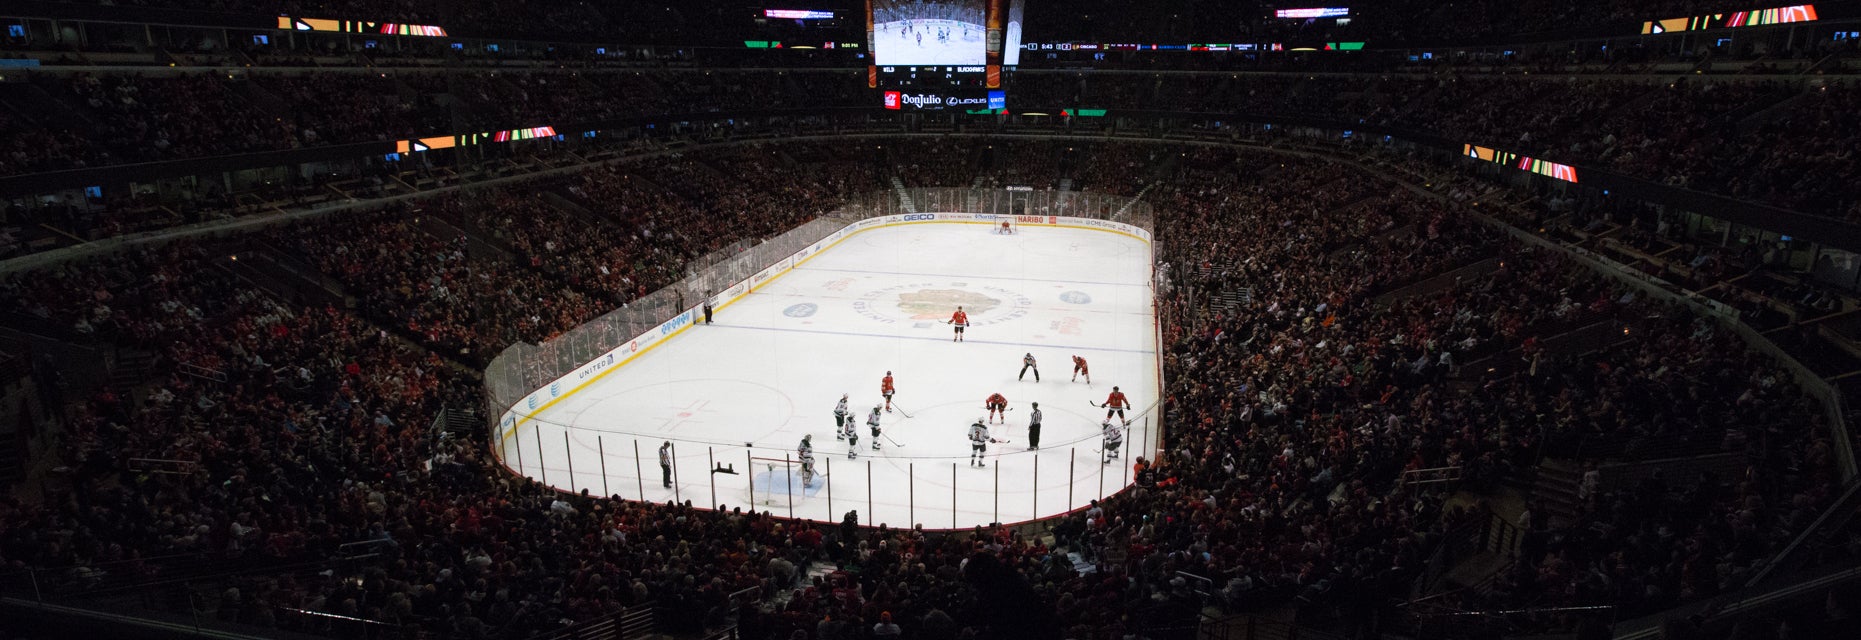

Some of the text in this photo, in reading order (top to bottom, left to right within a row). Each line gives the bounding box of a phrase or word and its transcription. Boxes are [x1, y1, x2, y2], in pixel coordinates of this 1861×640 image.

[904, 213, 935, 221] GEICO
[1017, 216, 1044, 224] HARIBO
[579, 360, 606, 379] UNITED
